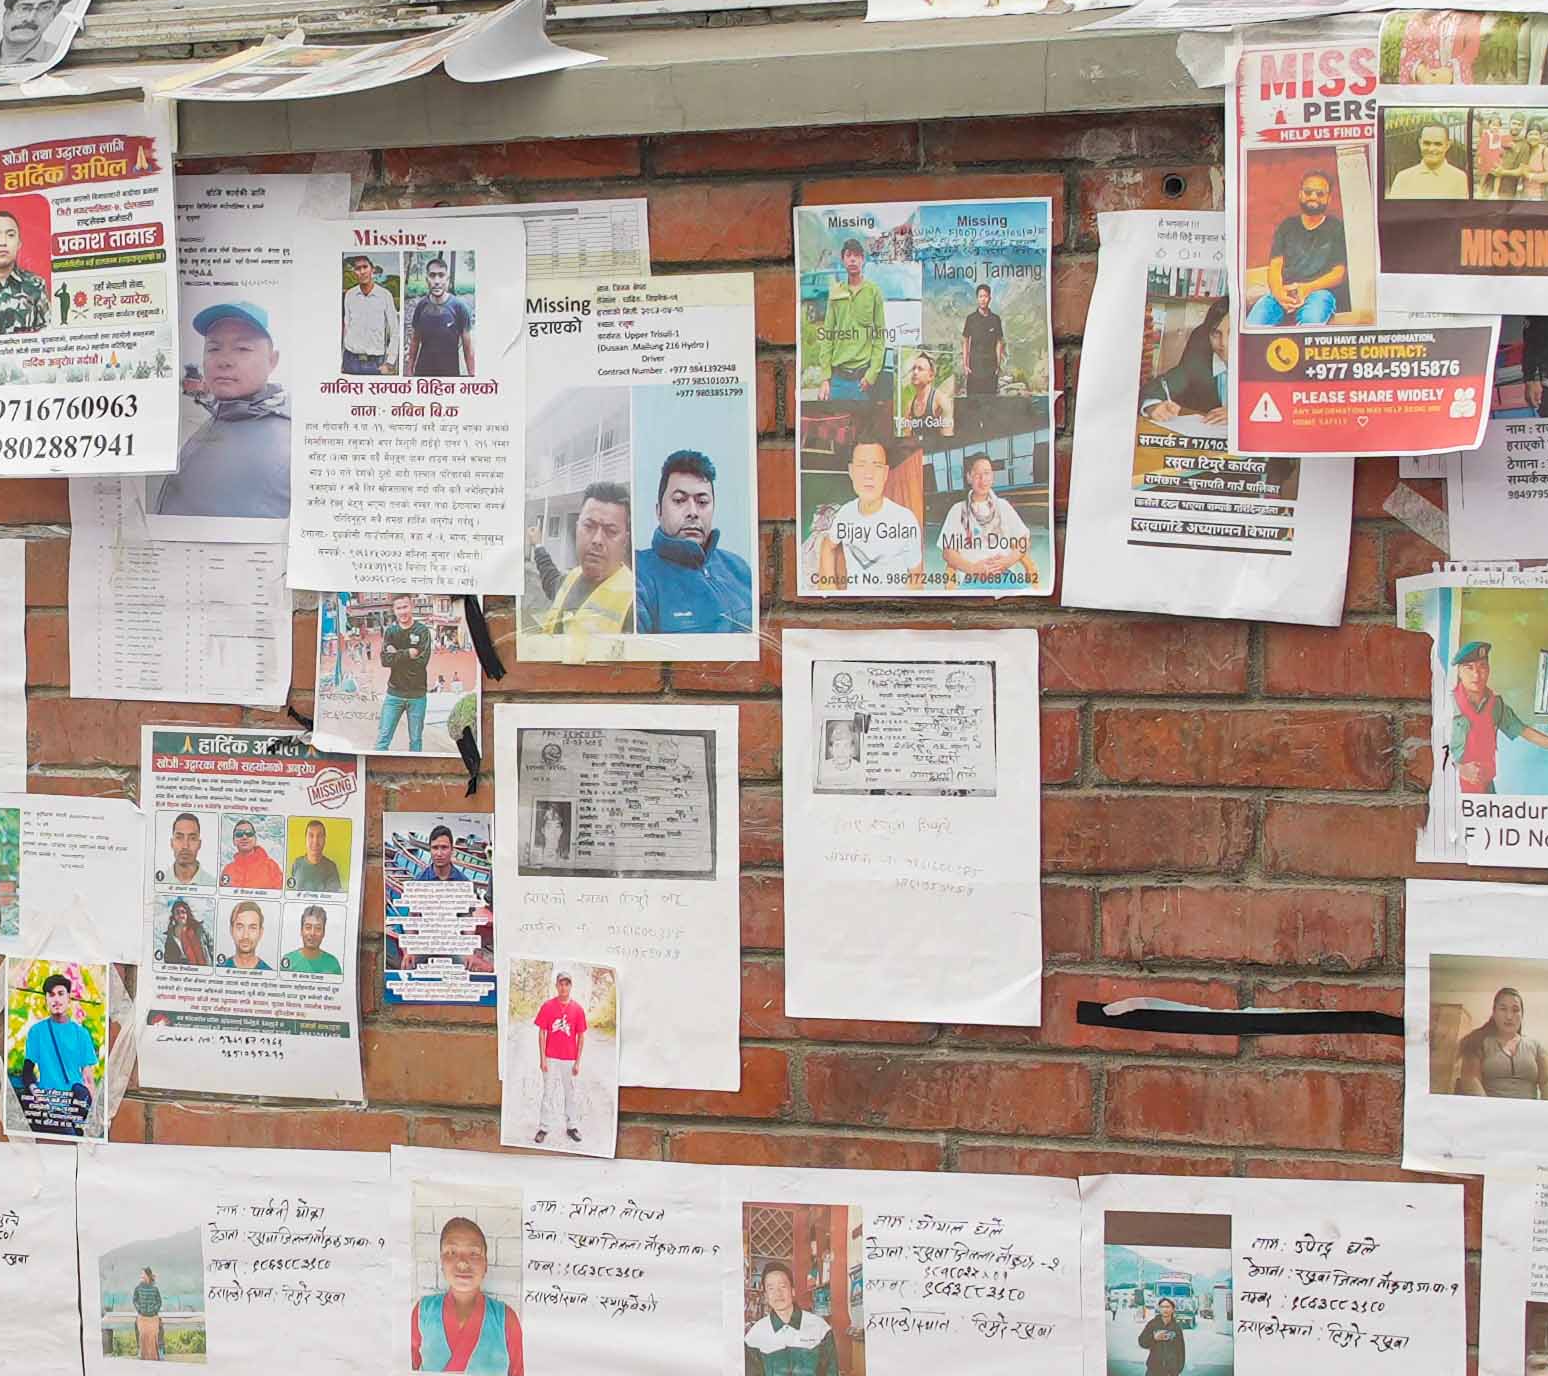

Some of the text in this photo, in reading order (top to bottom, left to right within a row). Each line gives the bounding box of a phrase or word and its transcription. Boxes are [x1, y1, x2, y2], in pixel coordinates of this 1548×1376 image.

[828, 216, 875, 229] Missing
[957, 214, 1007, 228] Missing
[57, 231, 106, 252] प्रकाश
[353, 228, 427, 249] Missing
[934, 261, 1042, 281] Manoj Tamang
[526, 296, 591, 316] Missing
[1305, 360, 1459, 379] +977 984-5915876
[1292, 388, 1443, 404] PLEASE SHARE WIDELY
[837, 522, 917, 543] Bijay Galan
[943, 532, 1027, 553] Milan Dong
[1461, 801, 1548, 821] Bahadur
[1499, 830, 1521, 847] ID
